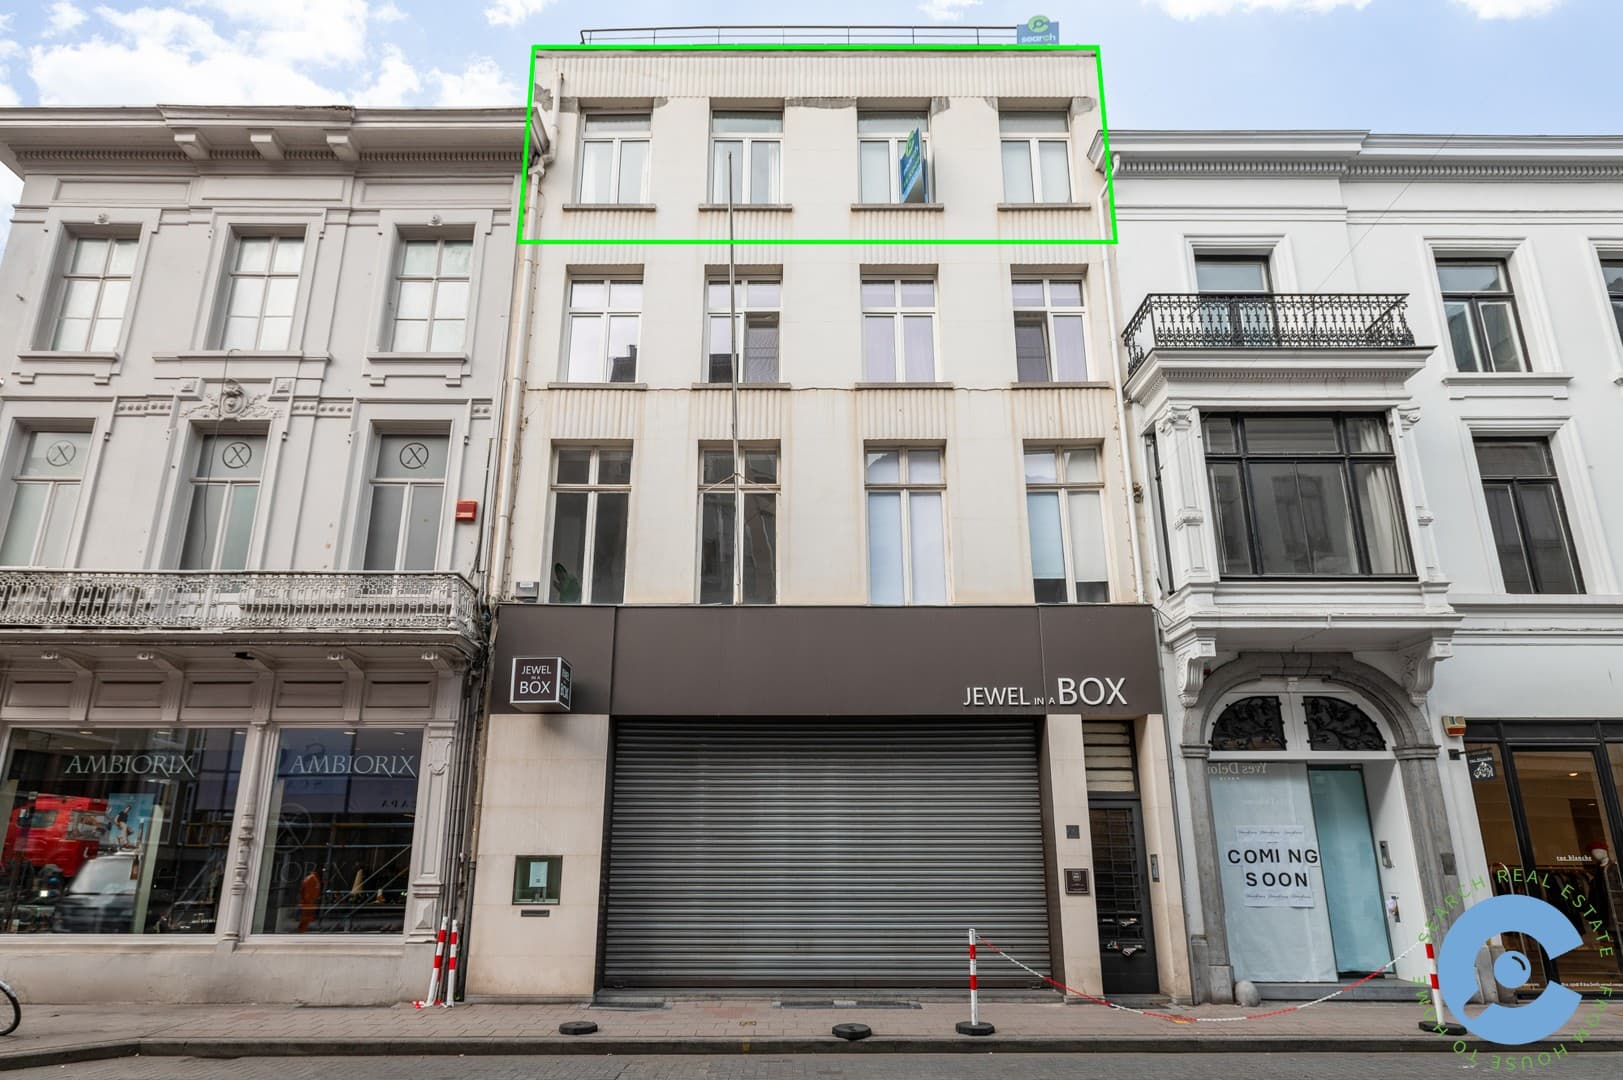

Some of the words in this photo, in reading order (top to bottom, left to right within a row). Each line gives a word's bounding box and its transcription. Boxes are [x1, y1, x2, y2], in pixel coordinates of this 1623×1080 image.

[521, 665, 551, 675] JEWEL
[519, 680, 551, 694] BOX
[963, 687, 1031, 706] JEWEL
[1034, 697, 1044, 705] IN
[1048, 697, 1056, 705] A
[1057, 677, 1128, 705] BOX
[64, 754, 196, 778] AMBIORIX
[288, 755, 417, 778] AMBIORIX
[1227, 848, 1319, 864] COMING
[1245, 872, 1308, 888] SOON
